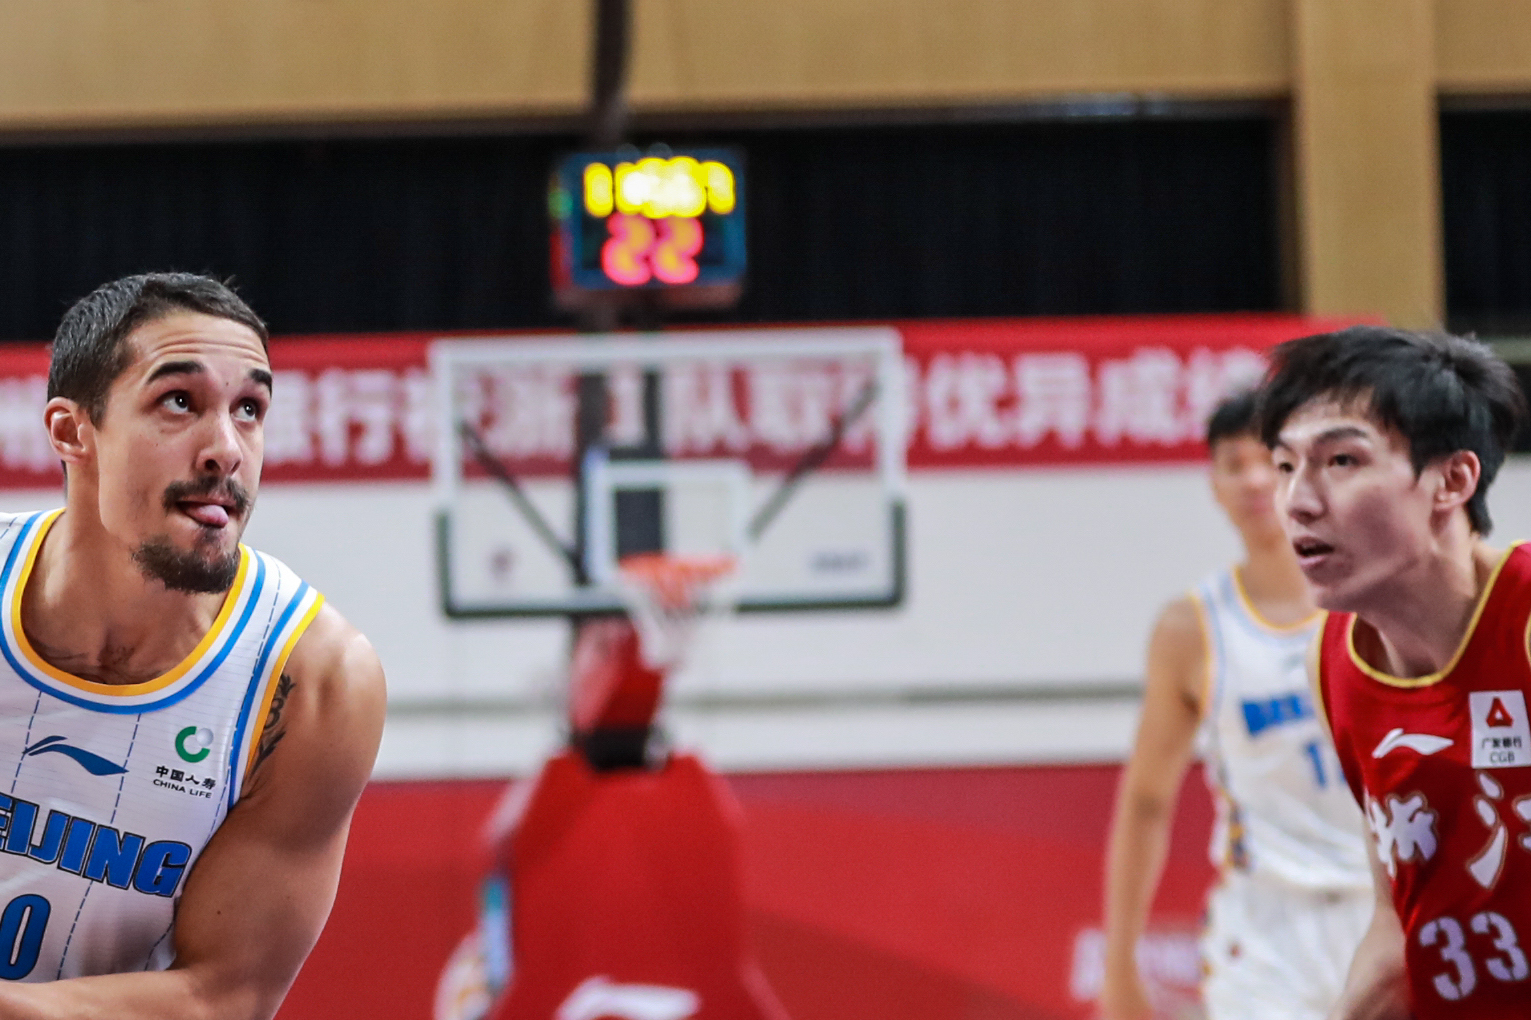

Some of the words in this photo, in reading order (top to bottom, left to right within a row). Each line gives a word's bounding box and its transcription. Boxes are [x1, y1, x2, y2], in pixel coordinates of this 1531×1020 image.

[153, 778, 186, 793] CHINA
[189, 788, 212, 799] LIFE
[155, 765, 216, 790] 中国人寿
[1419, 910, 1530, 1001] 33
